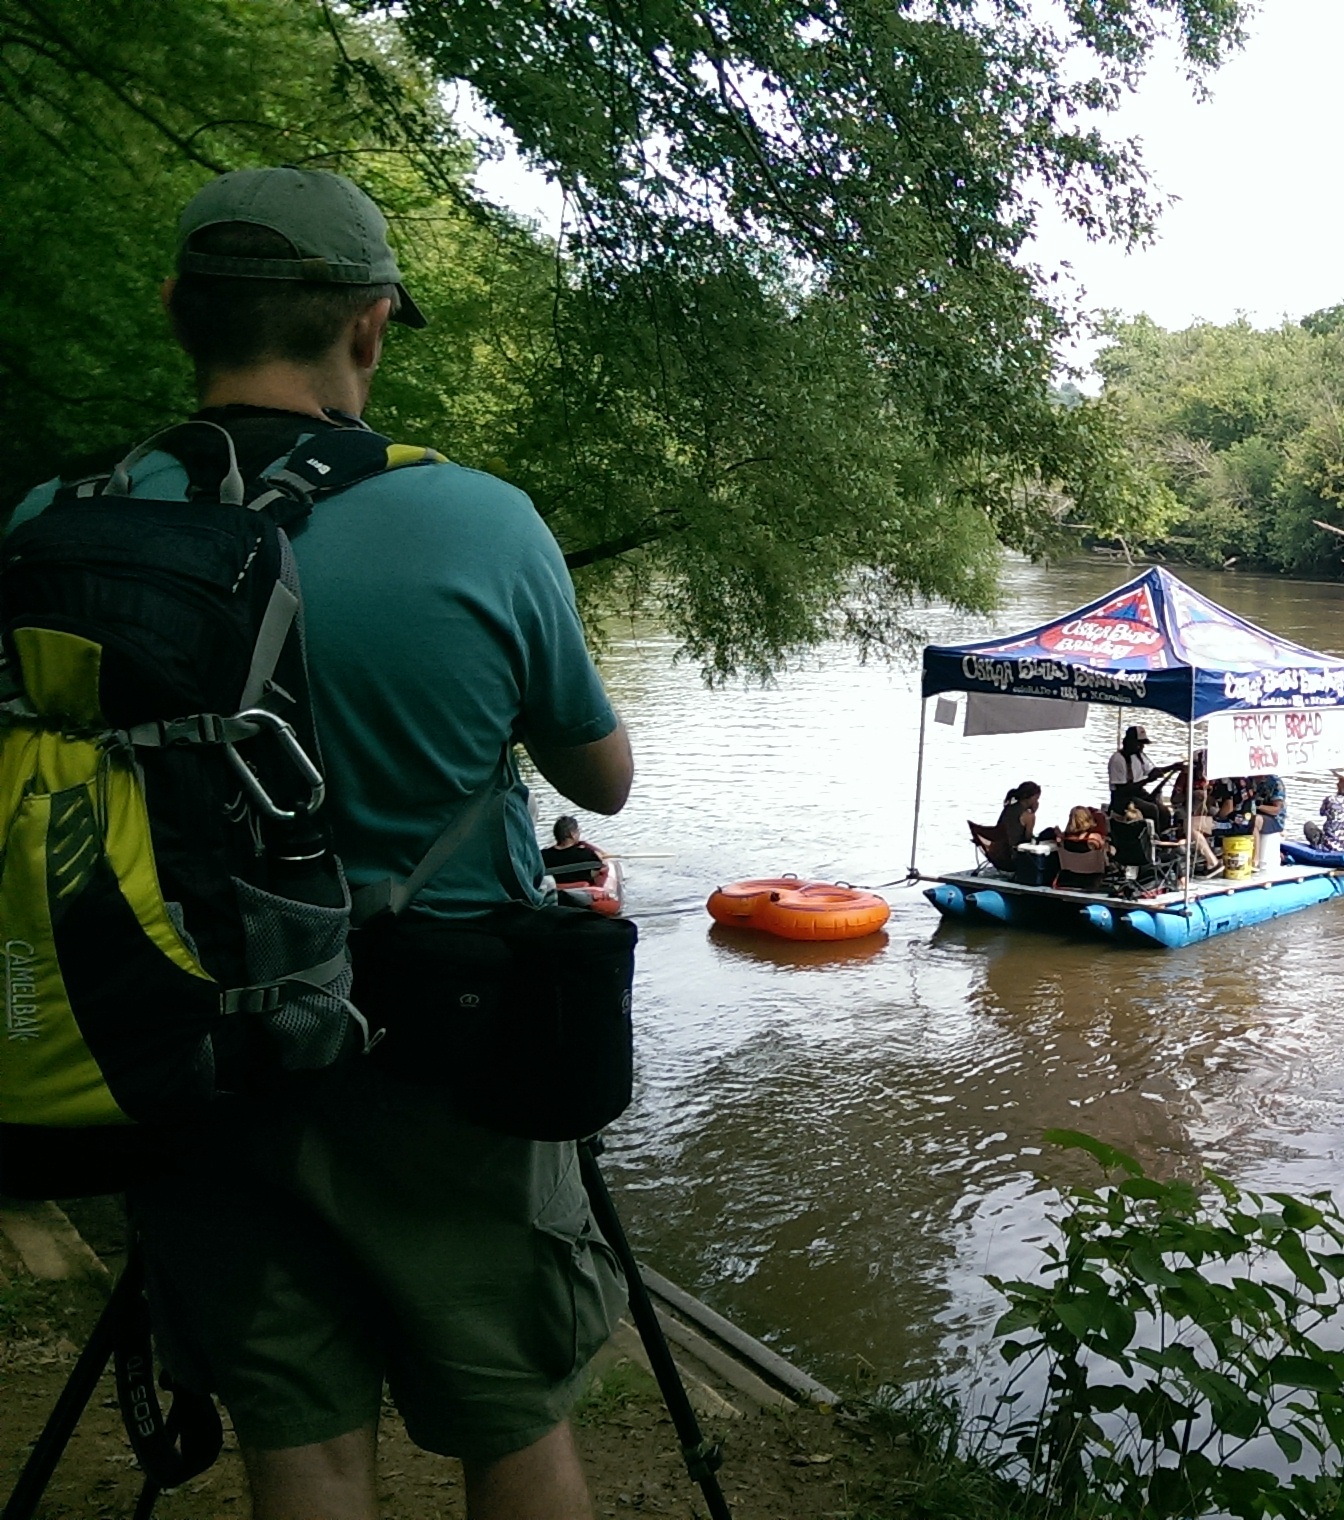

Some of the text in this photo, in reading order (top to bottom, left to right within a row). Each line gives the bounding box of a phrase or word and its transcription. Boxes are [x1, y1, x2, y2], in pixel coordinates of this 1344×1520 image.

[1233, 712, 1322, 743] FRENCH BROAD
[1249, 740, 1319, 770] BREW FEST
[6, 940, 40, 1041] CAMELBAK
[130, 1385, 155, 1437] EOS
